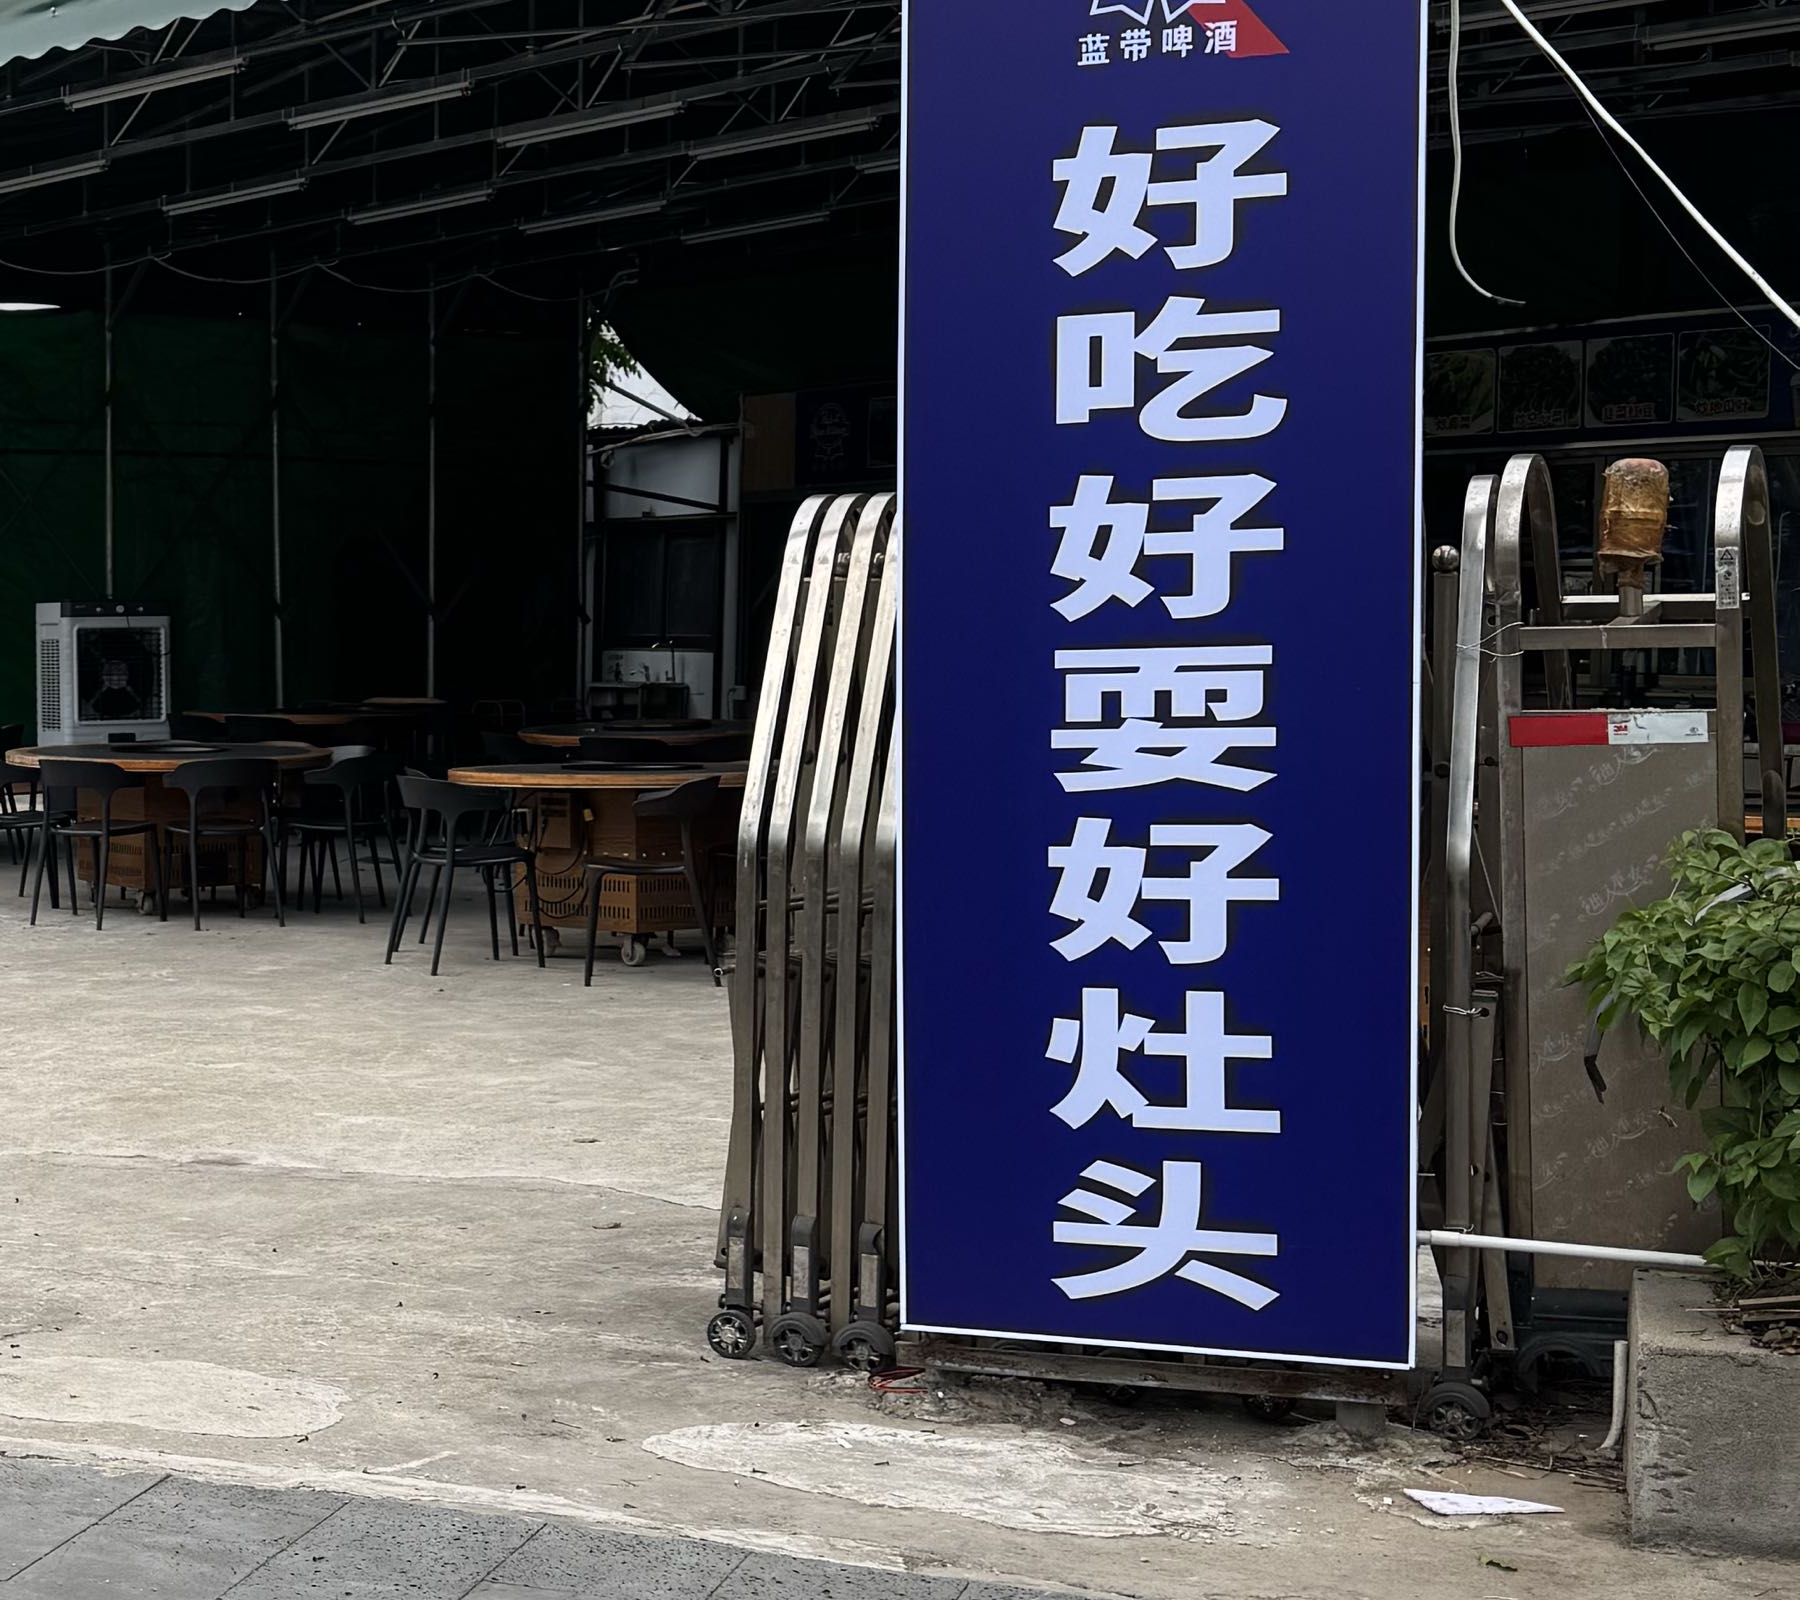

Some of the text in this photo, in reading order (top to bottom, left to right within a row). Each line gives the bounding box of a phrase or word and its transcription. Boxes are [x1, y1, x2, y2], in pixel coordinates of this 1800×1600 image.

[1077, 20, 1238, 66] 蓝带啤酒
[1044, 118, 1288, 1311] 好吃好耍好灶头
